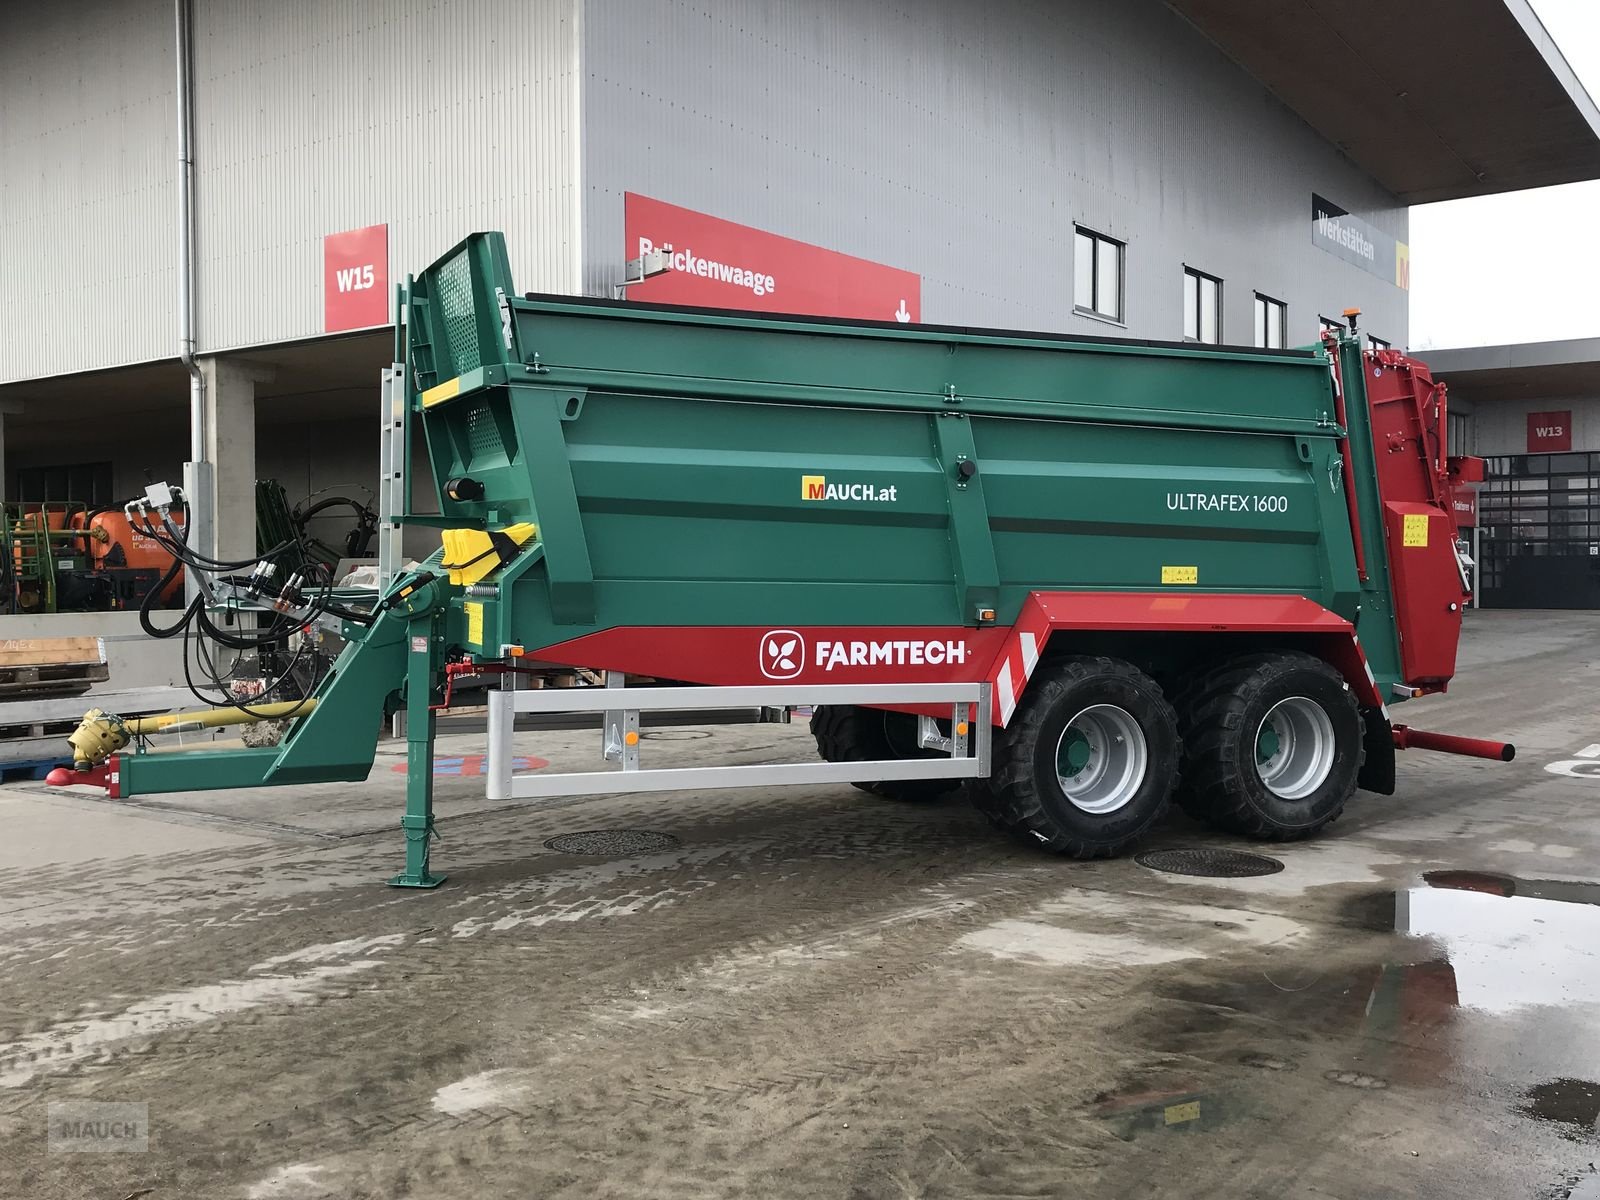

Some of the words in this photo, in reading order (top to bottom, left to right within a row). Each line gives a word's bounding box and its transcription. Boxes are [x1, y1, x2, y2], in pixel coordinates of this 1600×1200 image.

[1317, 209, 1375, 261] Werkstätten
[336, 264, 375, 292] W15
[1535, 426, 1563, 438] W13
[808, 483, 898, 502] MAUCH.at
[1166, 493, 1250, 512] ULTRAFEX
[1252, 495, 1288, 513] 1600
[815, 640, 965, 671] FARMTECH
